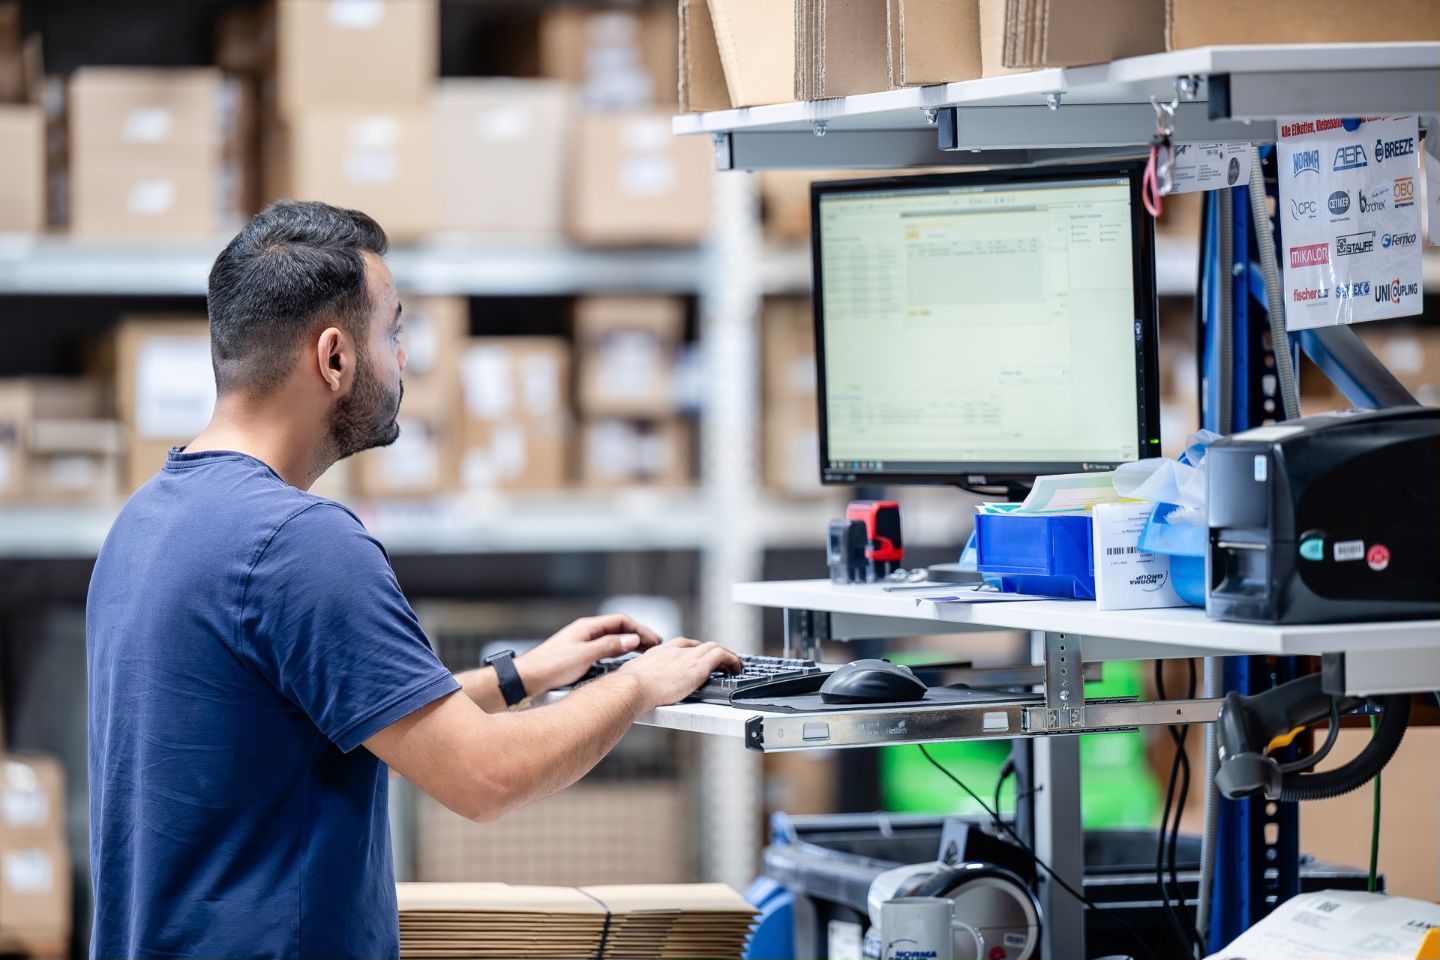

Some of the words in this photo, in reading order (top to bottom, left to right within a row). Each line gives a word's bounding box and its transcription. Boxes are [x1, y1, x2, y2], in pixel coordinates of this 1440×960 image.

[1384, 138, 1414, 159] BREEZE
[1293, 149, 1320, 174] NORMA
[1393, 181, 1414, 198] OBO
[1298, 200, 1317, 215] CPC
[1346, 240, 1373, 254] STAUFF
[1390, 232, 1417, 247] Fernco
[1291, 246, 1329, 265] MIKALOR
[1293, 287, 1317, 302] fischer
[895, 951, 938, 959] NORMA
